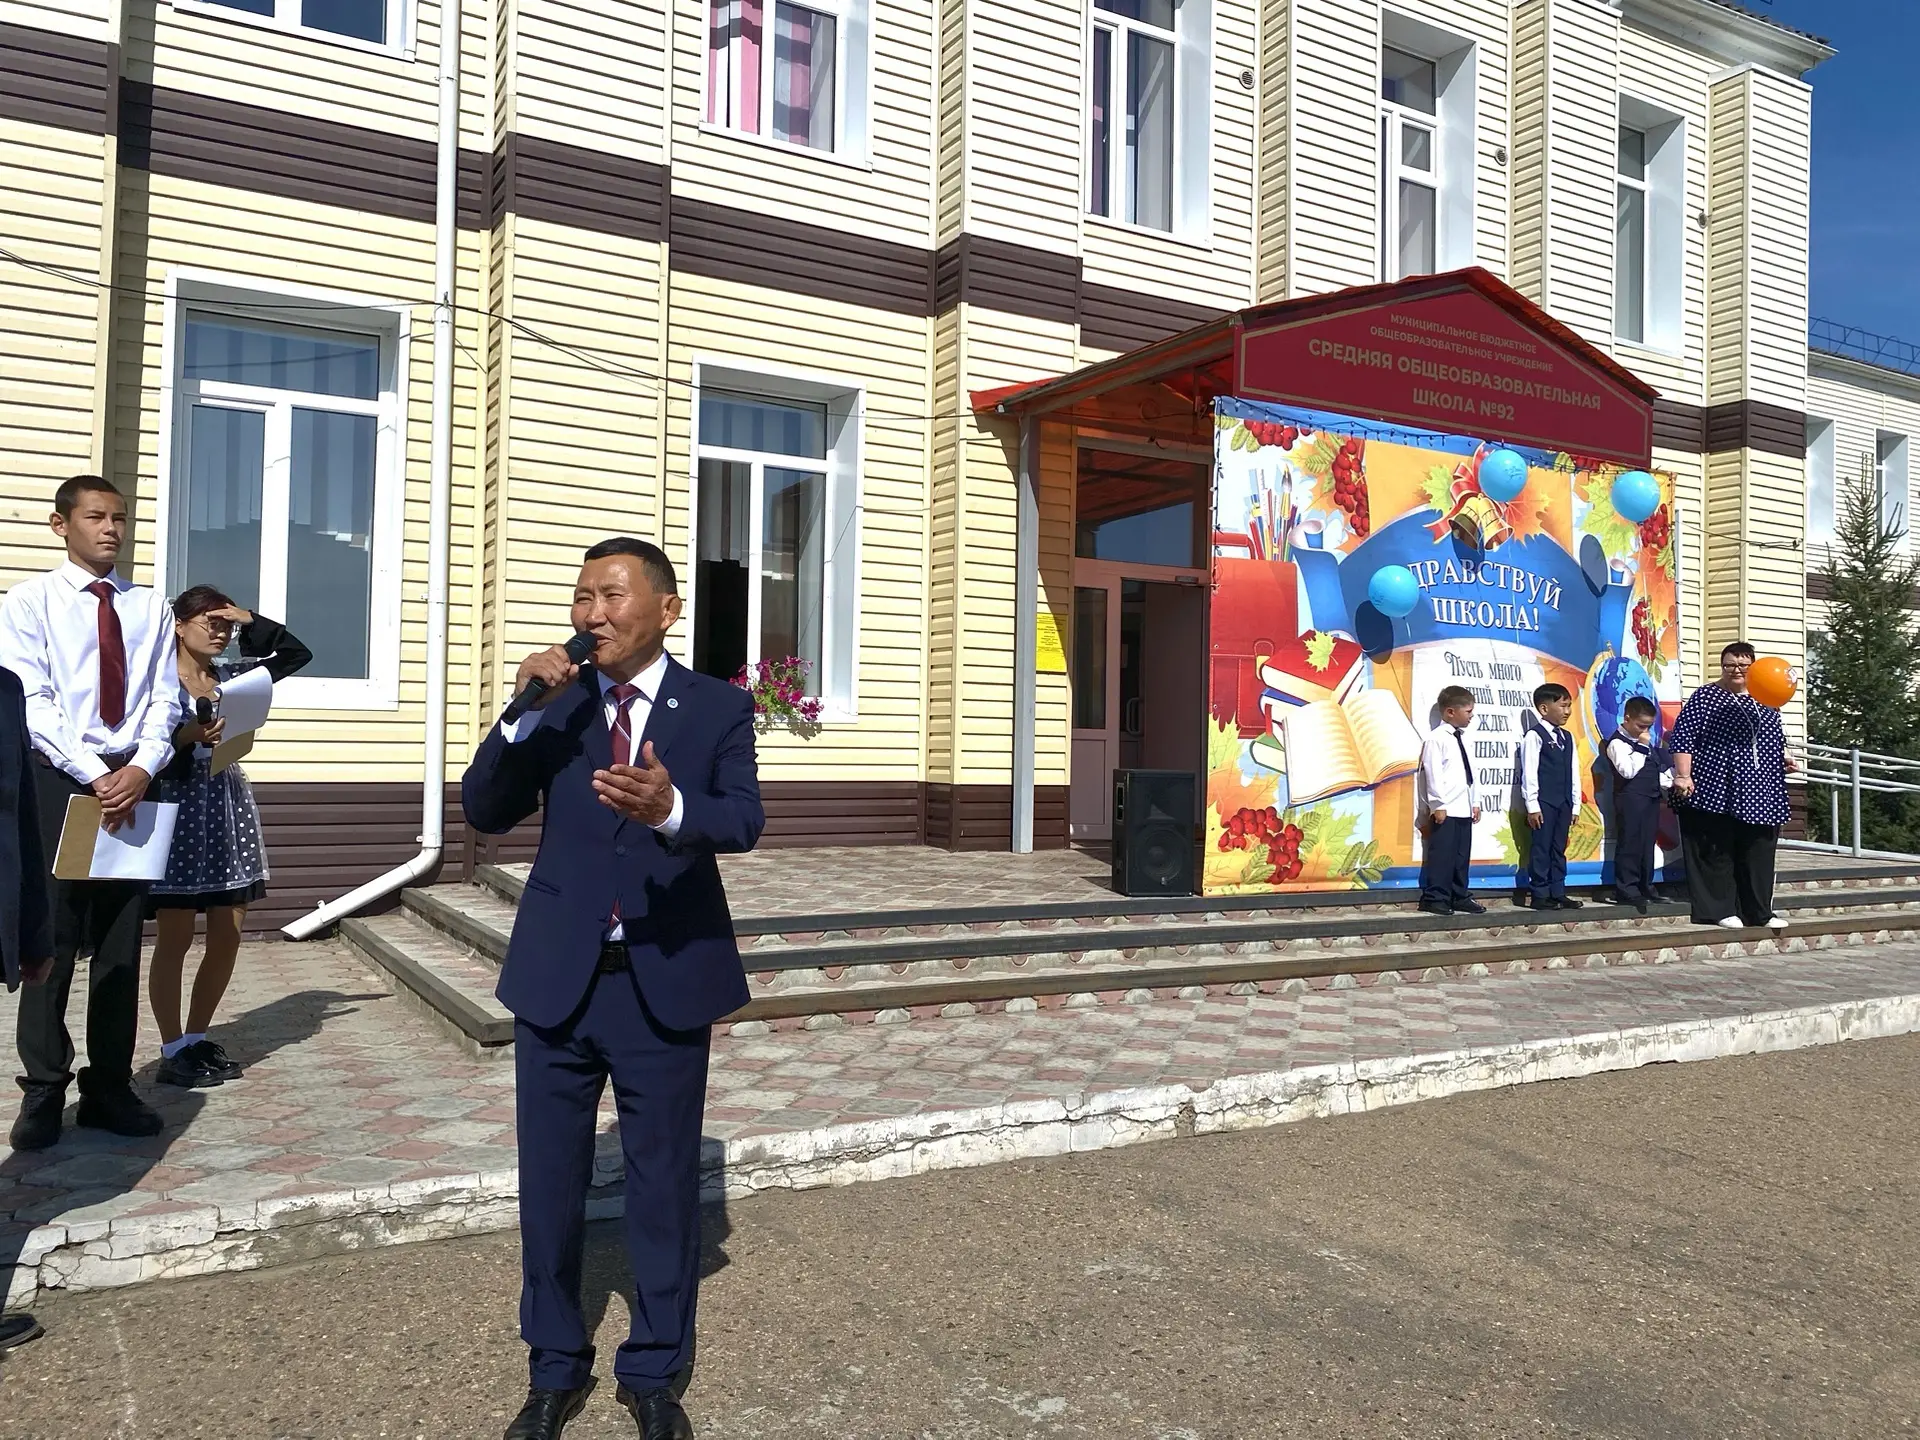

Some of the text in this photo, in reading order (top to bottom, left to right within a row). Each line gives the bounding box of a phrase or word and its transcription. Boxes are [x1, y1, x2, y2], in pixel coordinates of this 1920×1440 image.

[1370, 326, 1553, 372] ОБЩЕОБРАЗОВАТЕЛЬНОЕ УЧРЕЖДЕНИЕ
[1391, 314, 1536, 354] МУНИЦИПАЛЬНОЕ БЮДЖЕТНОЕ
[1309, 339, 1600, 410] СРЕДНЯЯ ОБЩЕОБРАЗОВАТЕЛЬНАЯ
[1413, 388, 1515, 421] ШКОЛА №92
[1407, 558, 1563, 611] ДРАВСТВУЙ
[1431, 596, 1541, 632] ШКОЛА!
